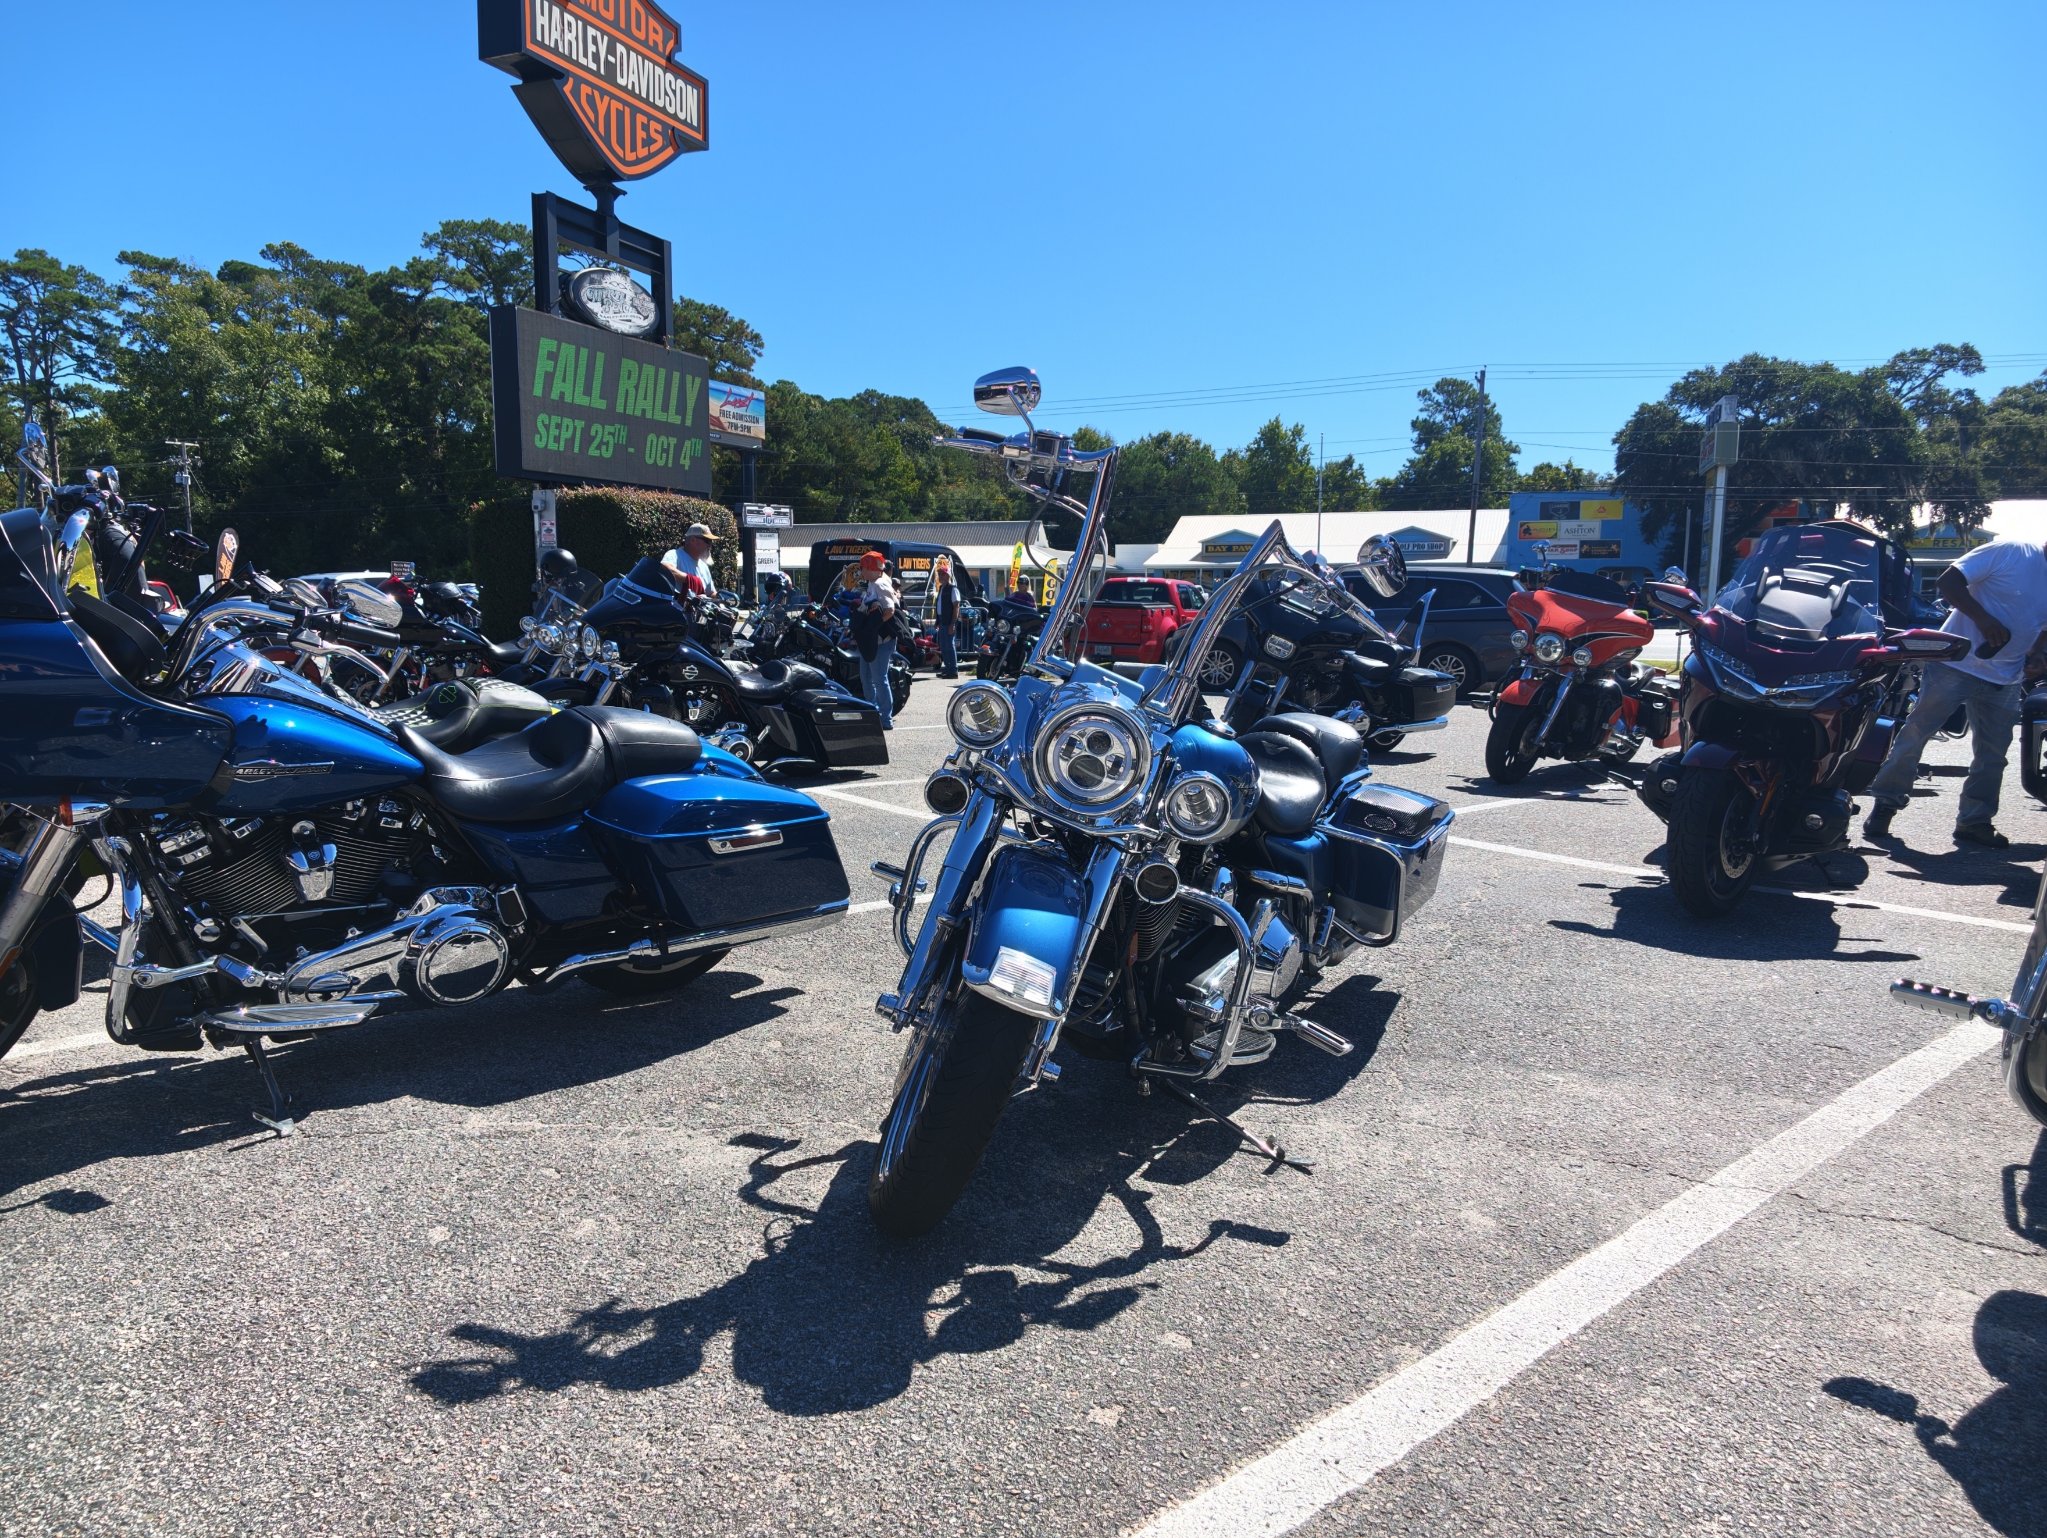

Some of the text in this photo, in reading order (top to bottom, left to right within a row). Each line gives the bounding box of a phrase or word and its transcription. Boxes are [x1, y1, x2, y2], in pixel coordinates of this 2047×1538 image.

[535, 0, 698, 127] HARLEY-DAVIDSON
[580, 83, 663, 161] CYCLES
[533, 337, 702, 427] FALL RALLY
[534, 412, 585, 453] SEPT
[588, 423, 628, 458] 25TH
[645, 433, 677, 468] OCT
[679, 438, 703, 471] 4TH
[824, 545, 873, 554] LAW TIGERS
[898, 558, 931, 569] LAW TIGERS
